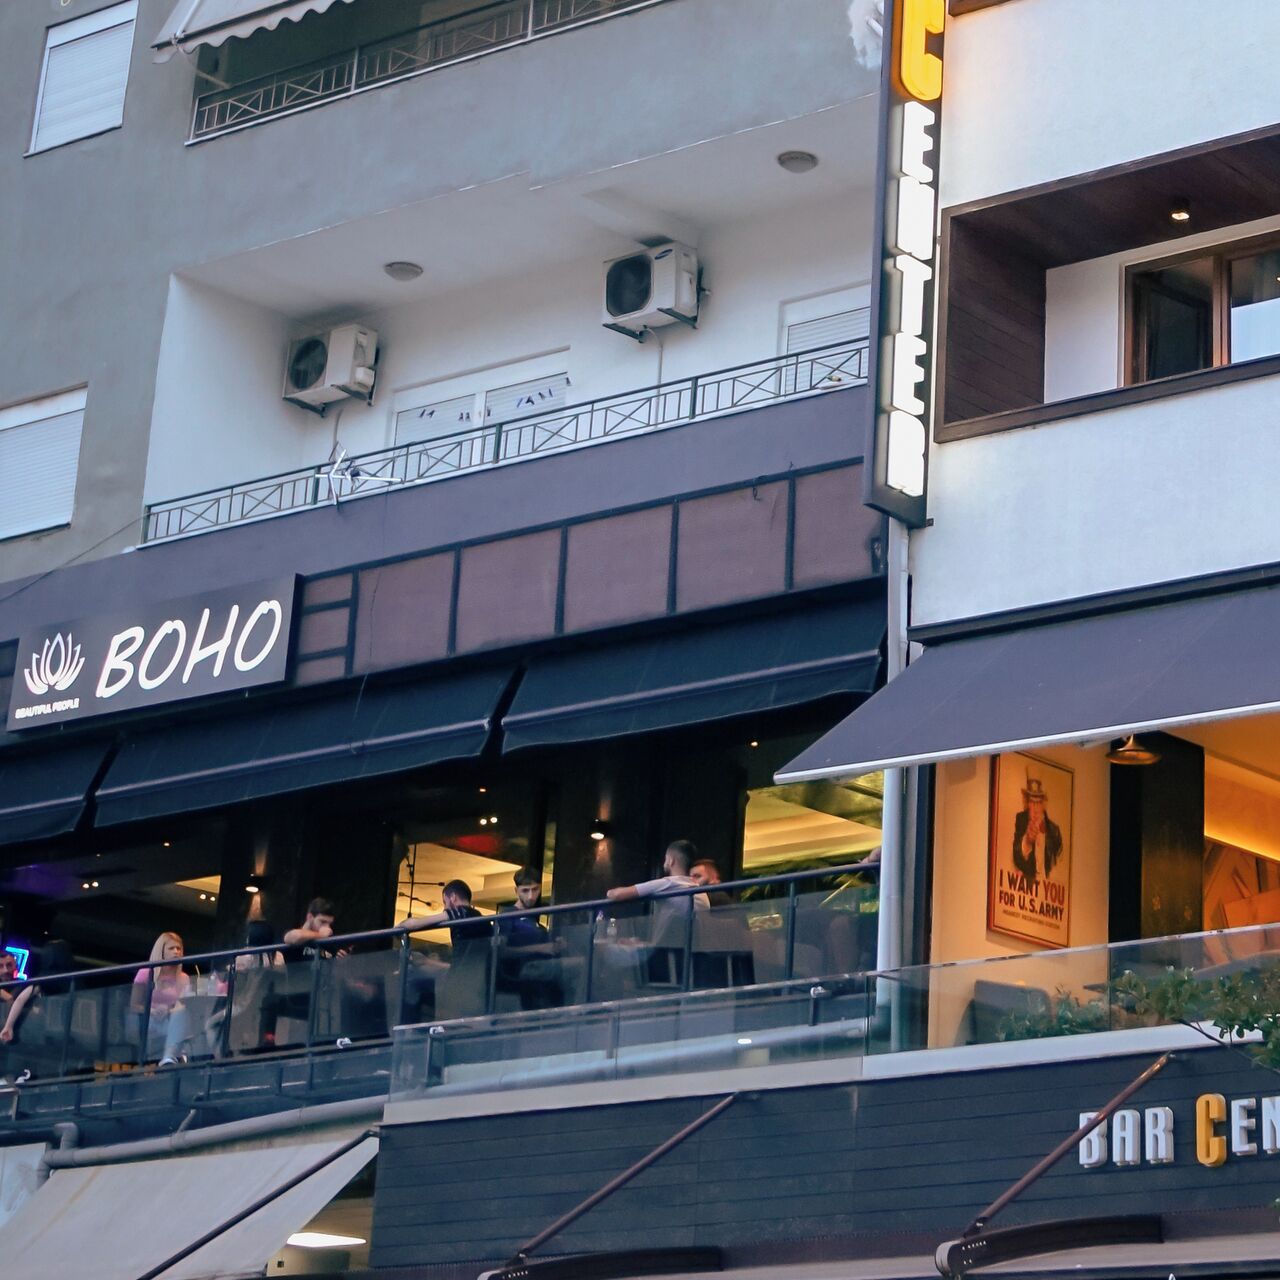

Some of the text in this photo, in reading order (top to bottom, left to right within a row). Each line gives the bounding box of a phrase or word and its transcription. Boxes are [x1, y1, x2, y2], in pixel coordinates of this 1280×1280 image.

[96, 600, 282, 698] BOHO
[999, 890, 1015, 907] FOR
[1039, 901, 1064, 921] ARMY
[1007, 871, 1040, 898] WANT
[1043, 880, 1065, 906] YOU
[1078, 1106, 1175, 1169] BAR
